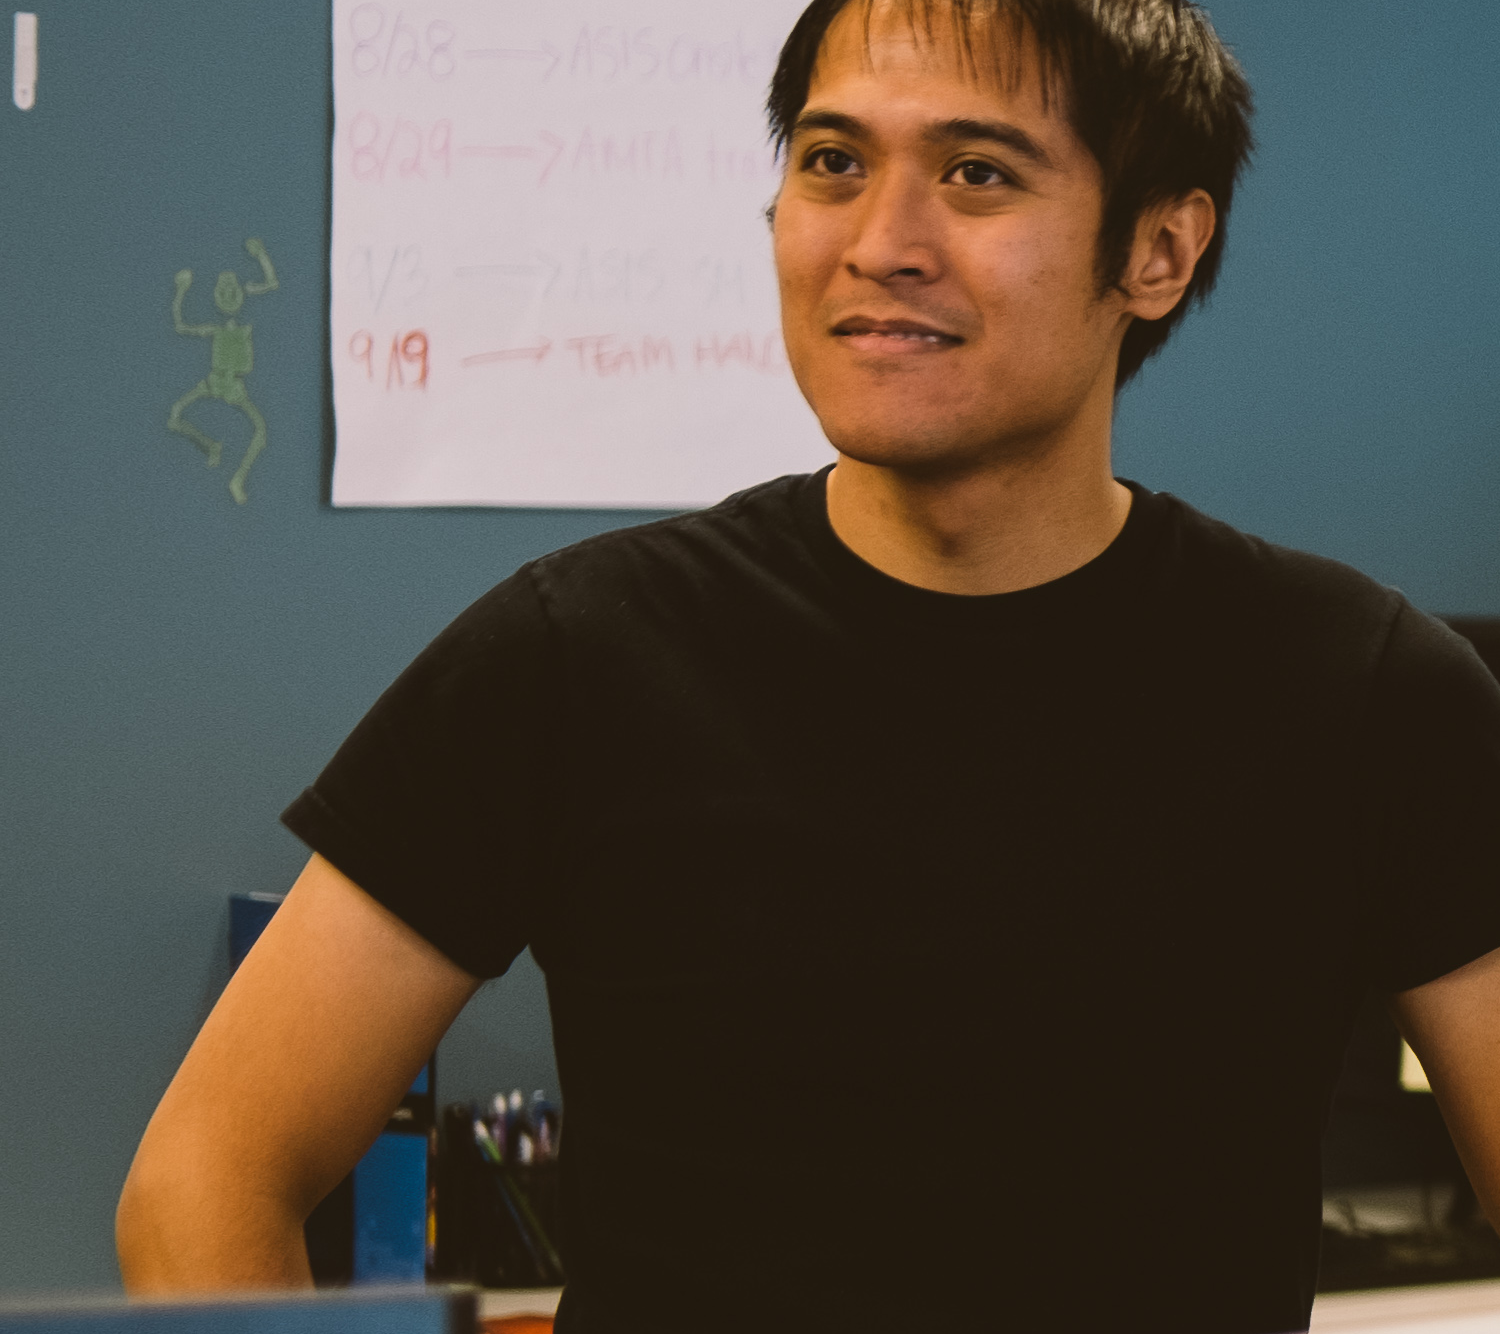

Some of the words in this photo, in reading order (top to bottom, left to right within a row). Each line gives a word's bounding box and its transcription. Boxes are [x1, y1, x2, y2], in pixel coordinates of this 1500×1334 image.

[349, 1, 457, 83] 8/28
[348, 110, 455, 184] 8/29
[563, 331, 678, 379] TEAM
